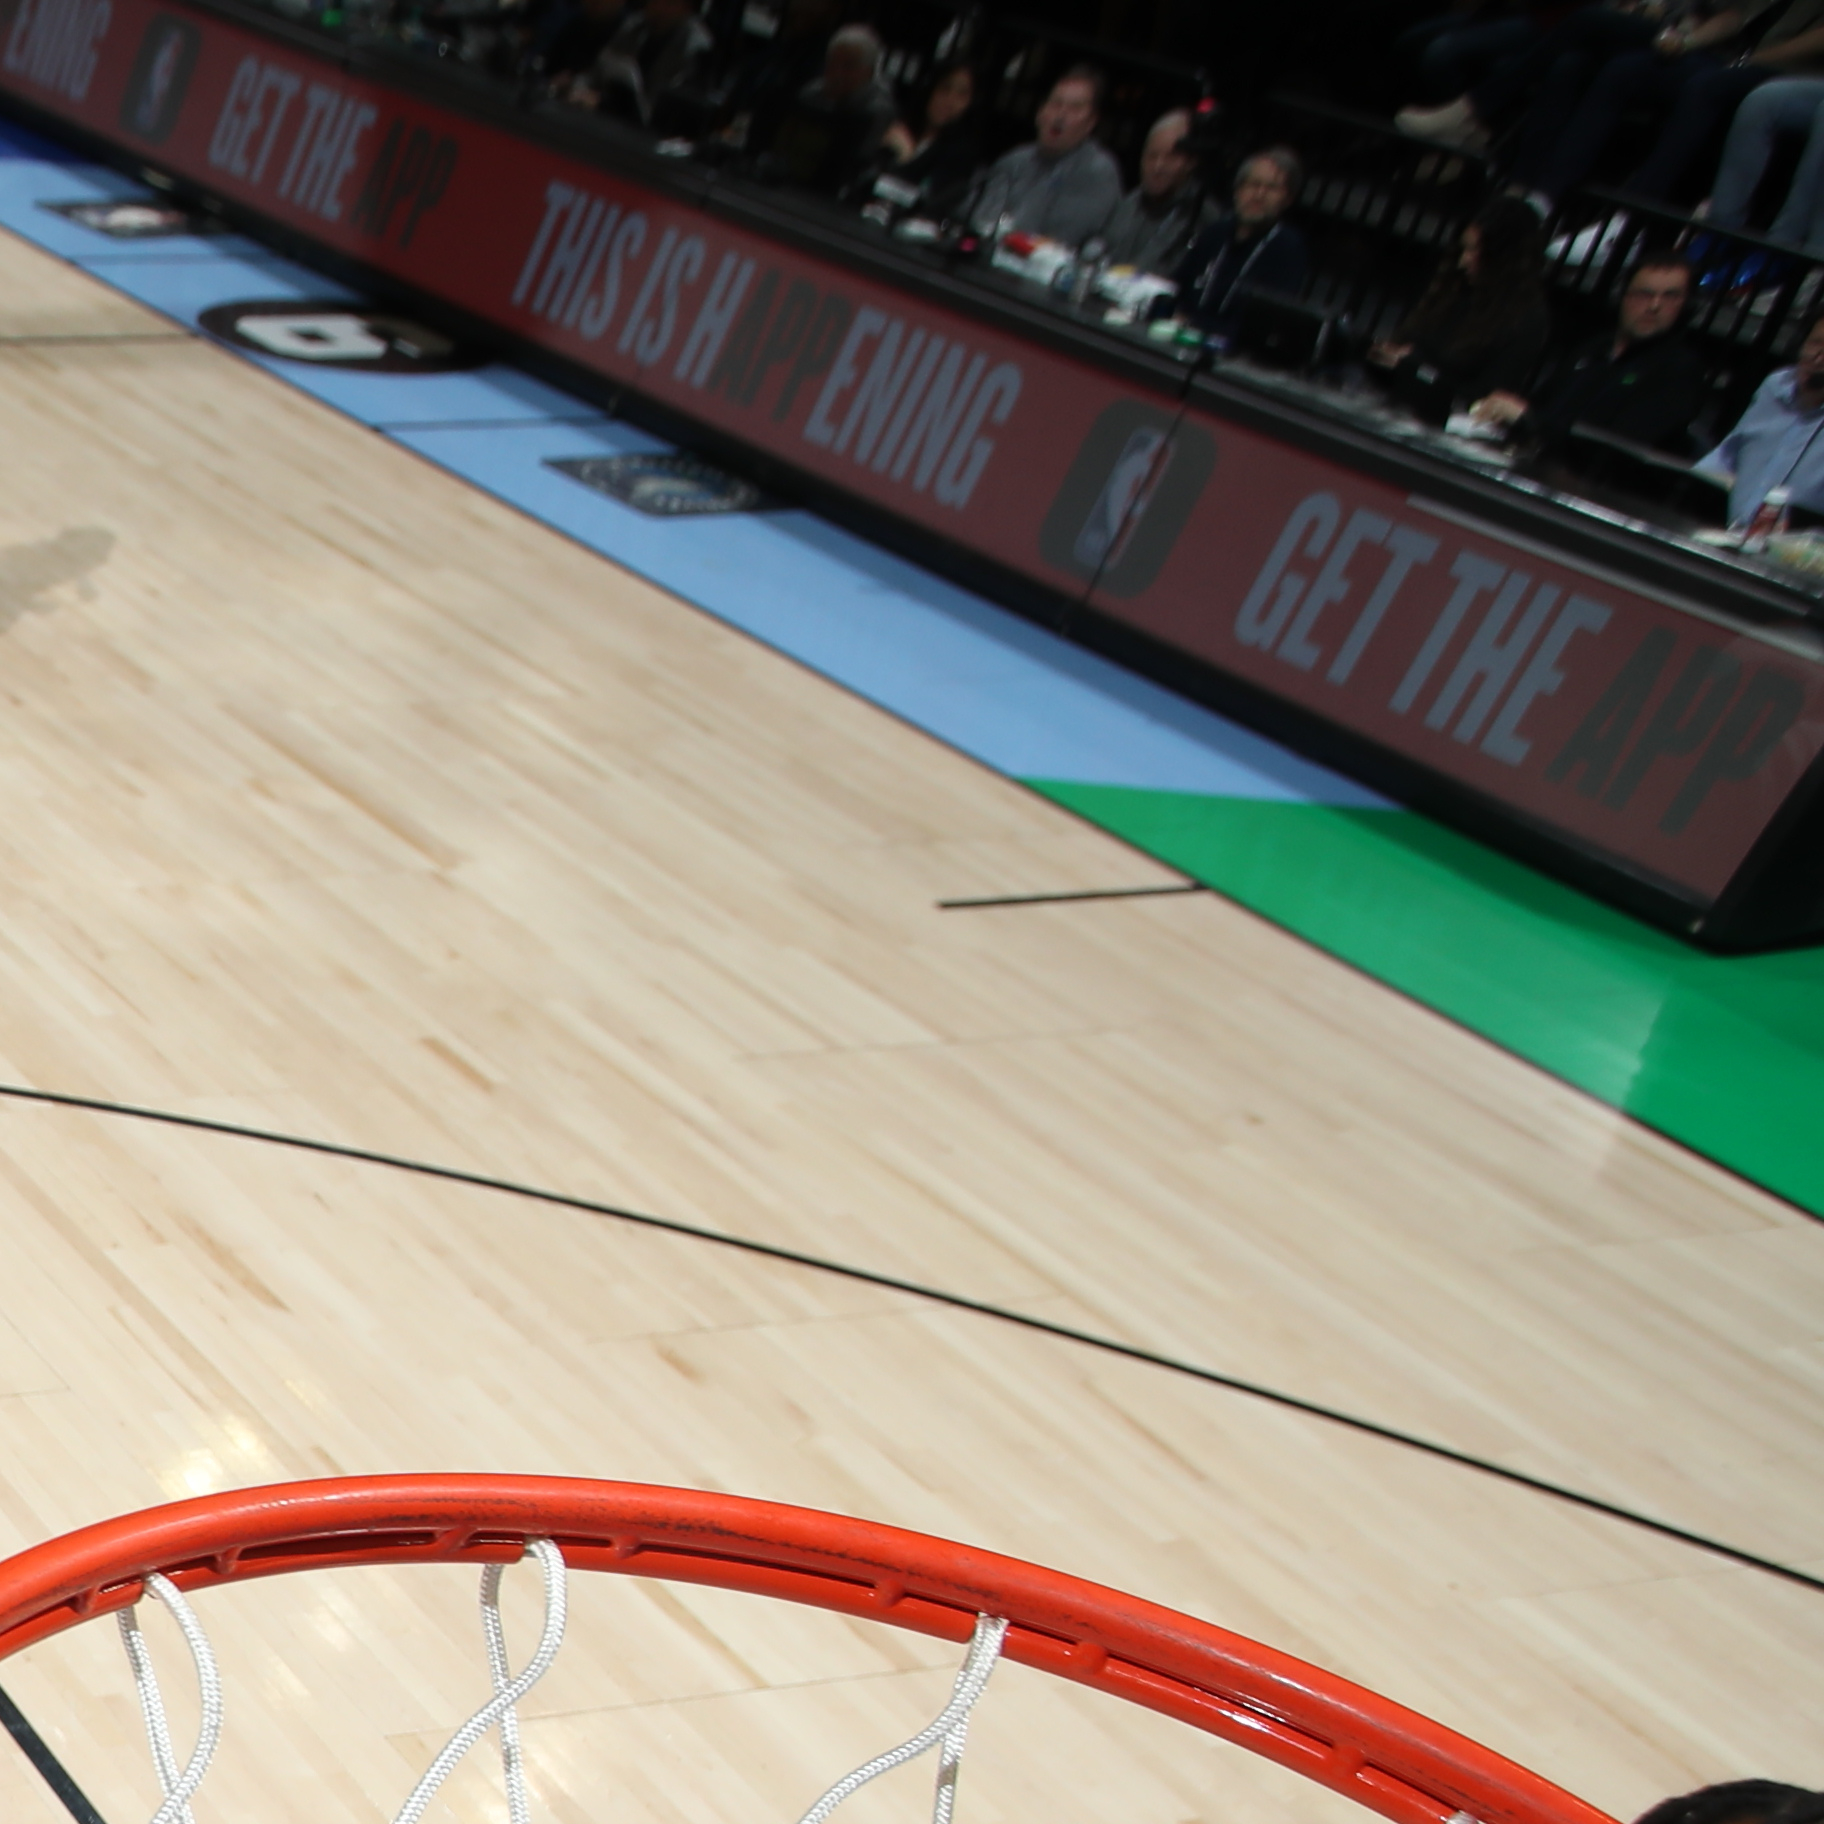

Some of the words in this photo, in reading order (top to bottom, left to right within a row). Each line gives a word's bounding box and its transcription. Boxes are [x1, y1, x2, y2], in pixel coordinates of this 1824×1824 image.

[209, 53, 300, 186] GET
[277, 81, 379, 222] THE
[348, 115, 458, 249] APP
[511, 179, 650, 342] THIS
[616, 225, 705, 367] IS
[673, 250, 1023, 511] HAPPENING
[1233, 490, 1442, 688] GET
[1387, 548, 1613, 768] THE
[1544, 626, 1810, 837] APP
